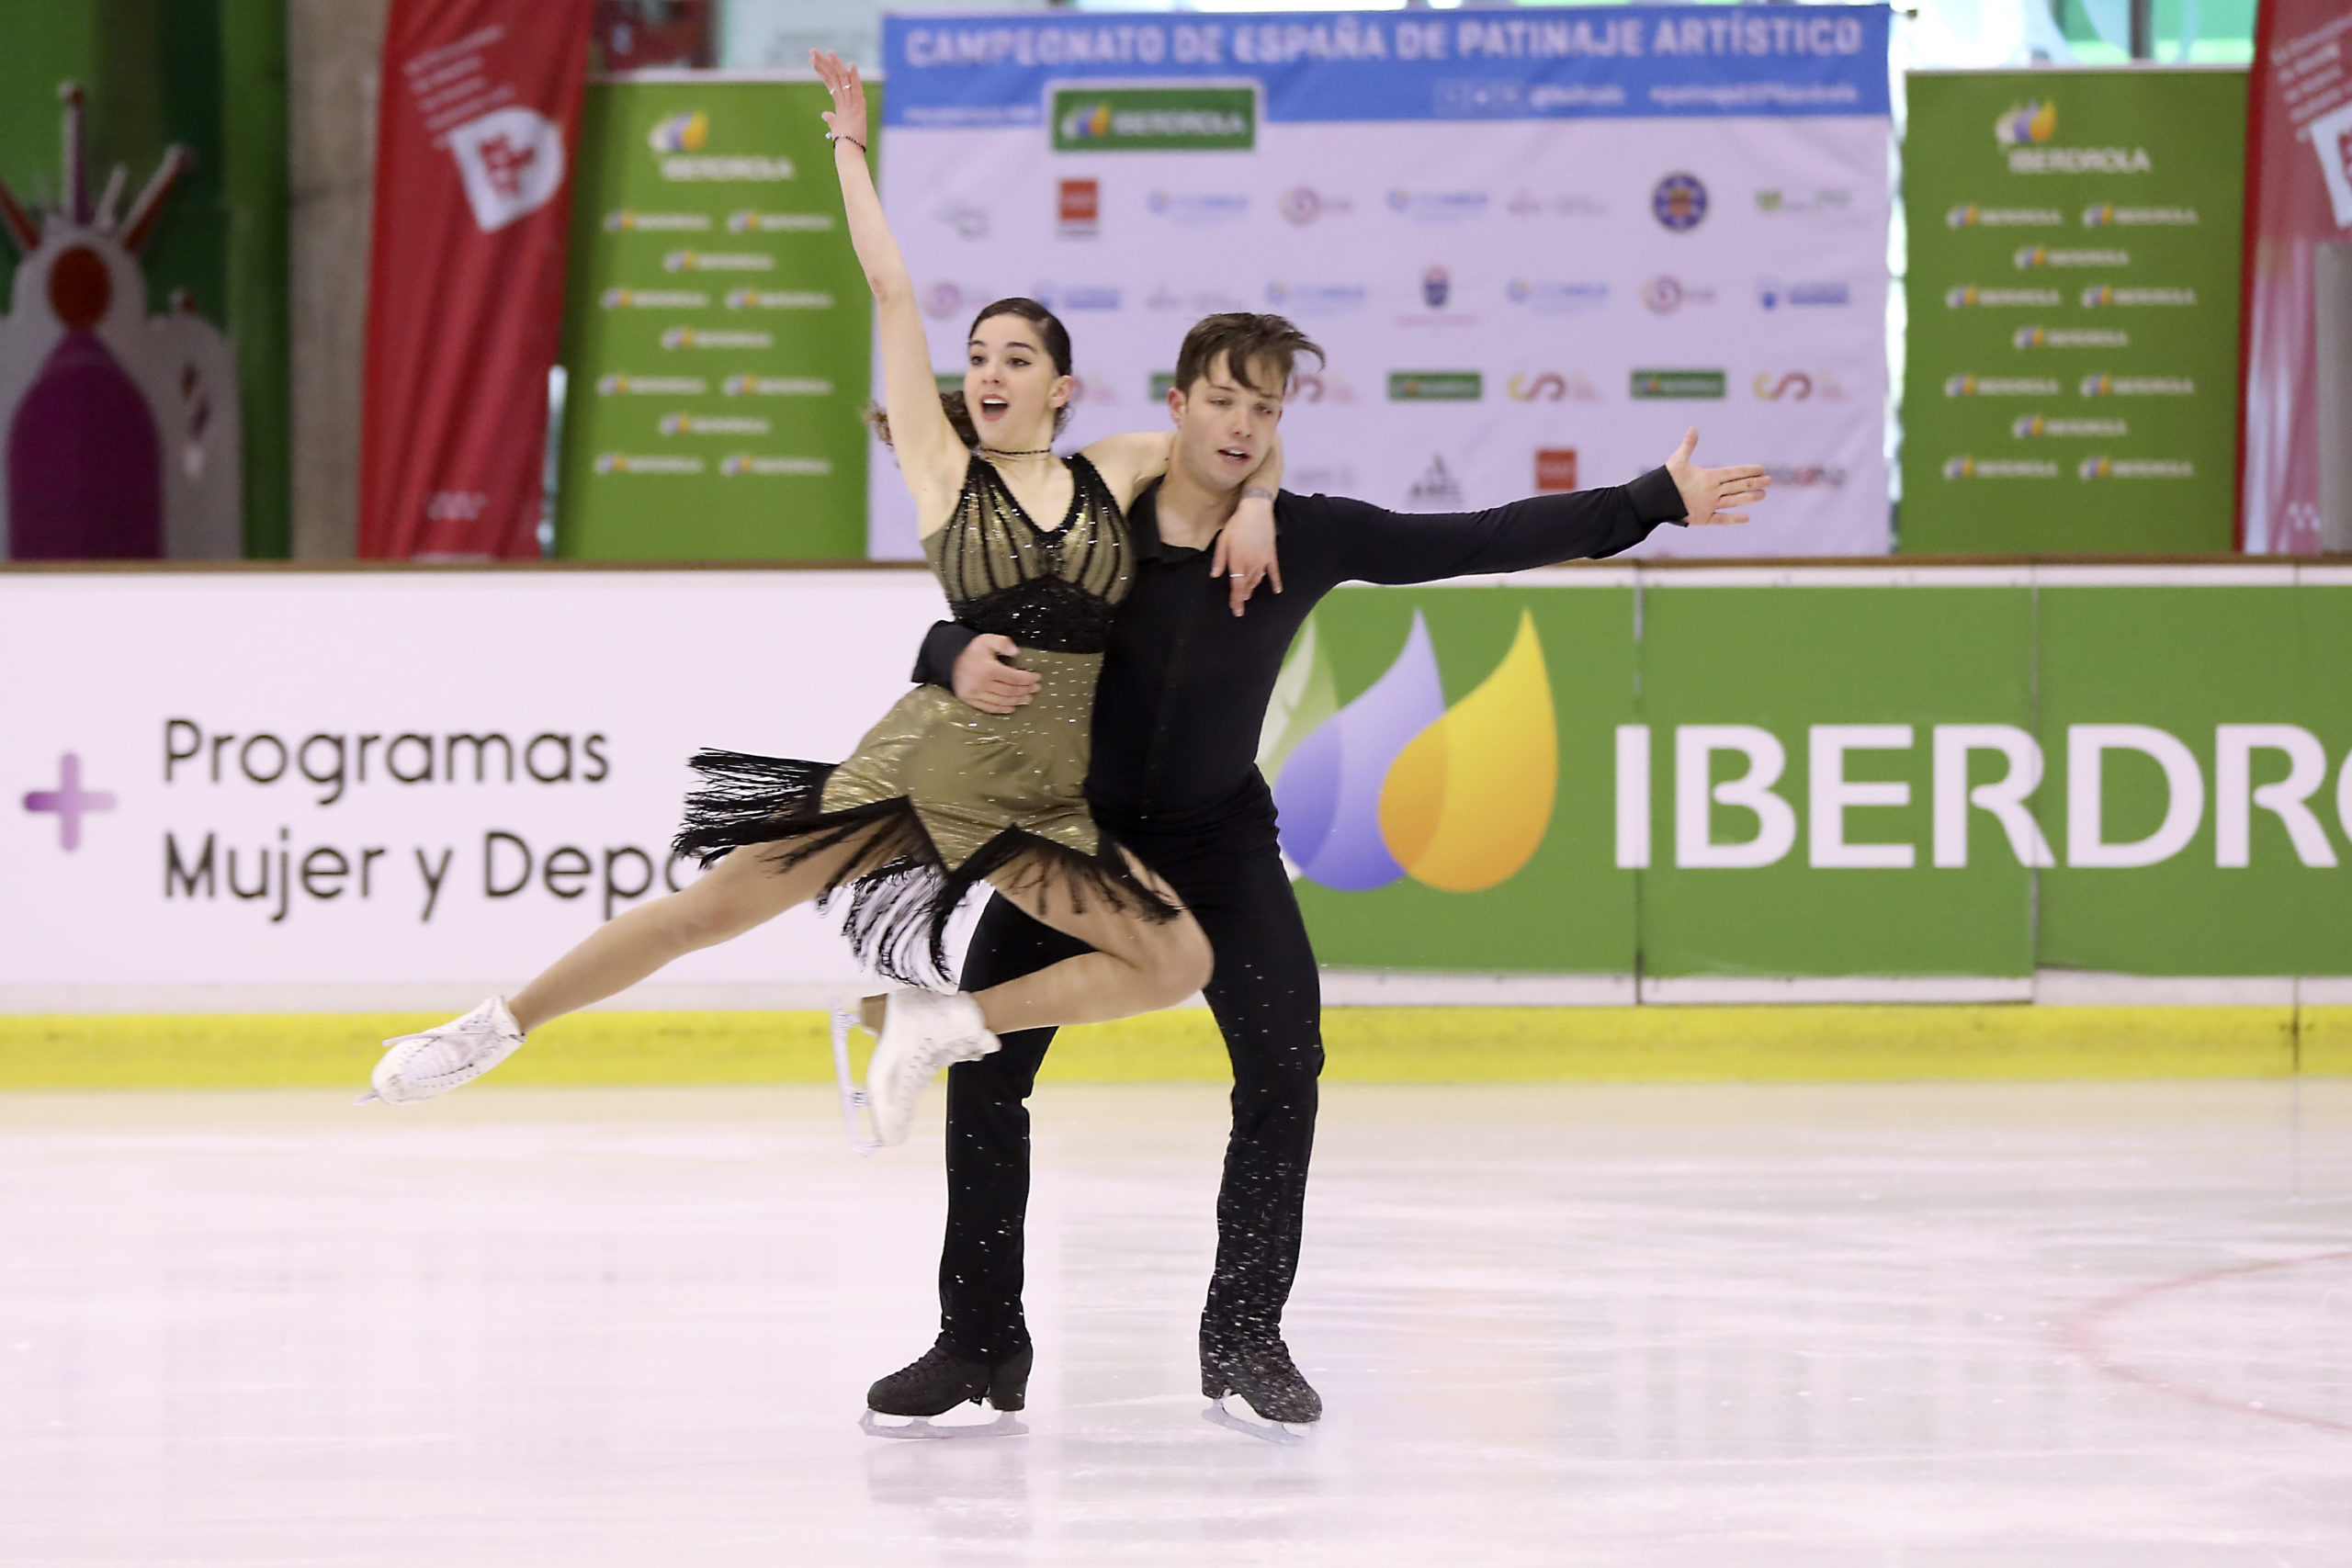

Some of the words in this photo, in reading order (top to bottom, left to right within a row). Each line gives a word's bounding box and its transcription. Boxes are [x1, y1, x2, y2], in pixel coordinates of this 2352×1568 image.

[905, 25, 1165, 67] CAMPEONATO
[1173, 25, 1225, 62] DE
[1234, 16, 1387, 64] ESPAÑA
[1396, 21, 1446, 61] DE
[1457, 18, 1643, 58] PATINAJE
[1653, 14, 1862, 56] ARTÍSTICO
[164, 718, 609, 806] Programas
[1614, 724, 2352, 868] IBERDR
[164, 829, 386, 922] Mujer
[415, 849, 453, 921] y
